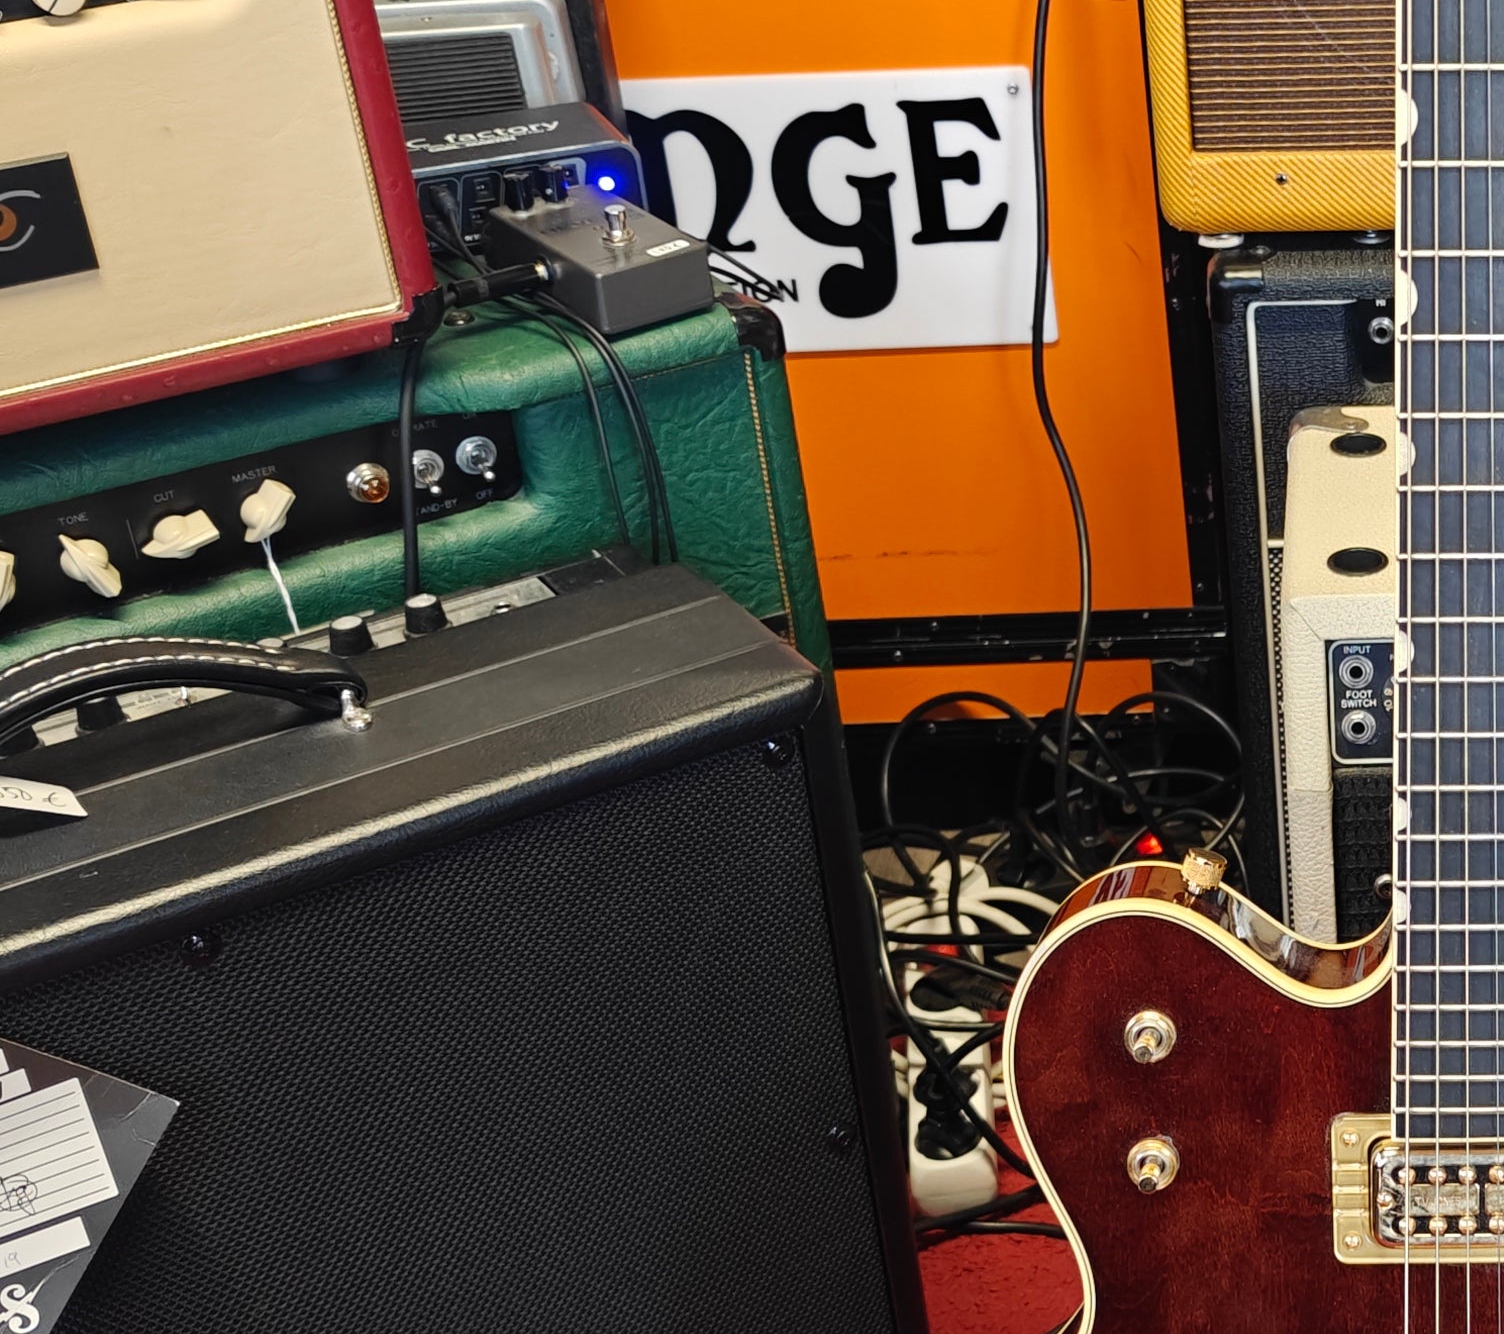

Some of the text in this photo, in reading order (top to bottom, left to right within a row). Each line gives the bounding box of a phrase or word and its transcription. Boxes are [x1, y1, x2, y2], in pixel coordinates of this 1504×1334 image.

[444, 119, 560, 145] factory
[625, 95, 1009, 318] NGE
[231, 464, 278, 484] MASTER
[153, 489, 175, 503] CUT
[58, 512, 89, 526] TONE
[1343, 645, 1371, 655] INPUT
[1345, 689, 1373, 699] FOOT
[1340, 698, 1378, 709] SWITCH
